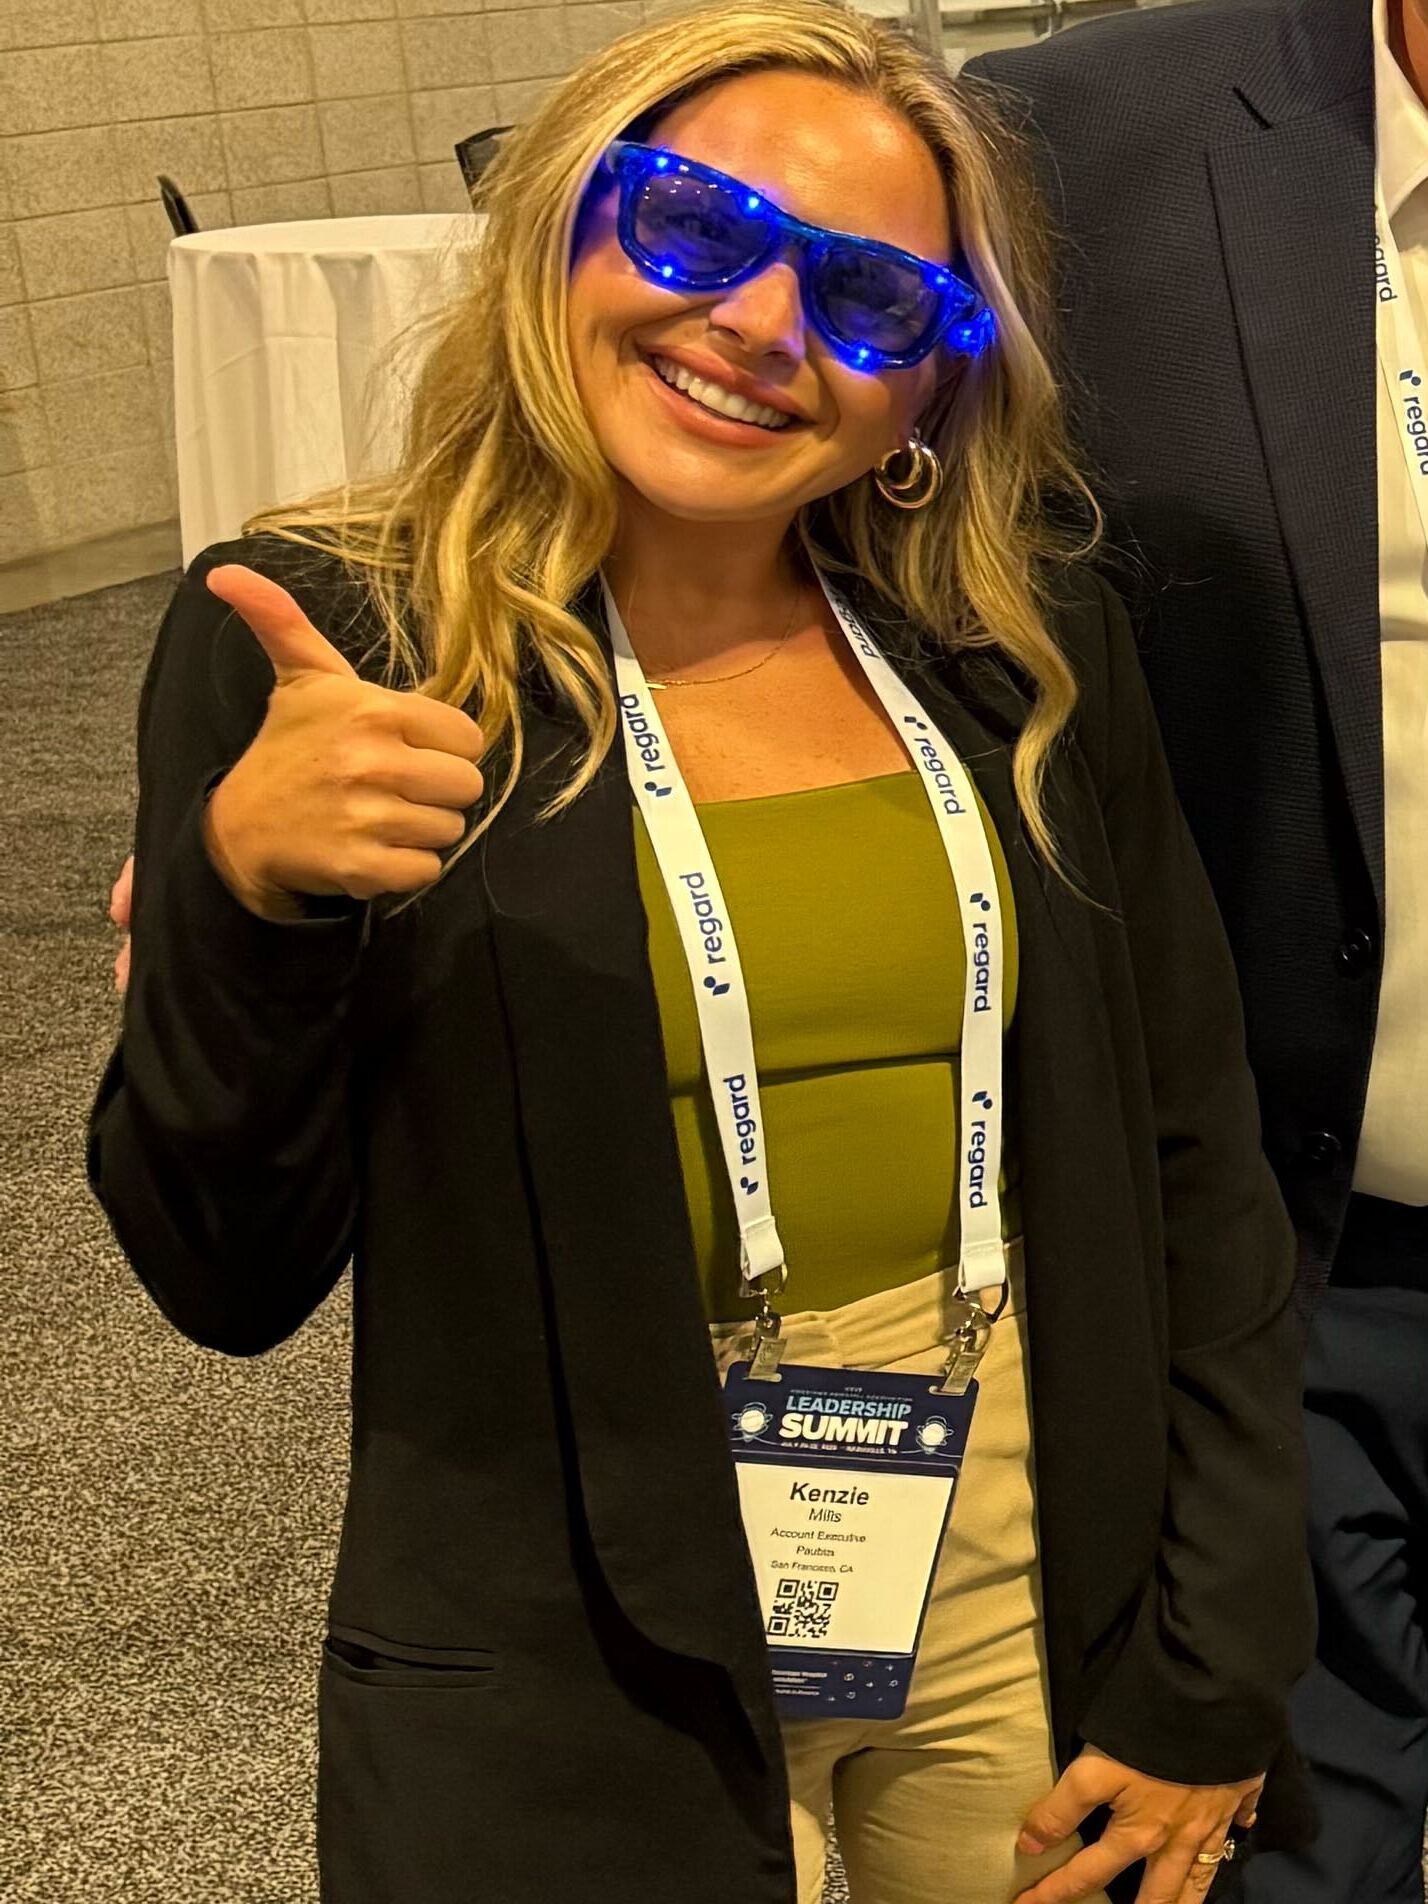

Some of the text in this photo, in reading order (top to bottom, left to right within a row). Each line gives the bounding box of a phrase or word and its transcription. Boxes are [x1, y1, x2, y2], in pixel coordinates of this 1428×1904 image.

[1375, 235, 1399, 302] ard
[620, 693, 665, 773] regard
[915, 737, 966, 815] regard
[680, 872, 725, 965] regard
[973, 922, 992, 1013] regard
[723, 1073, 757, 1165] regard
[968, 1120, 987, 1209] regard
[779, 1413, 908, 1446] SUMMIT
[786, 1395, 911, 1419] LEADERSHIP
[789, 1482, 869, 1505] Kenzie
[770, 1528, 814, 1539] Account
